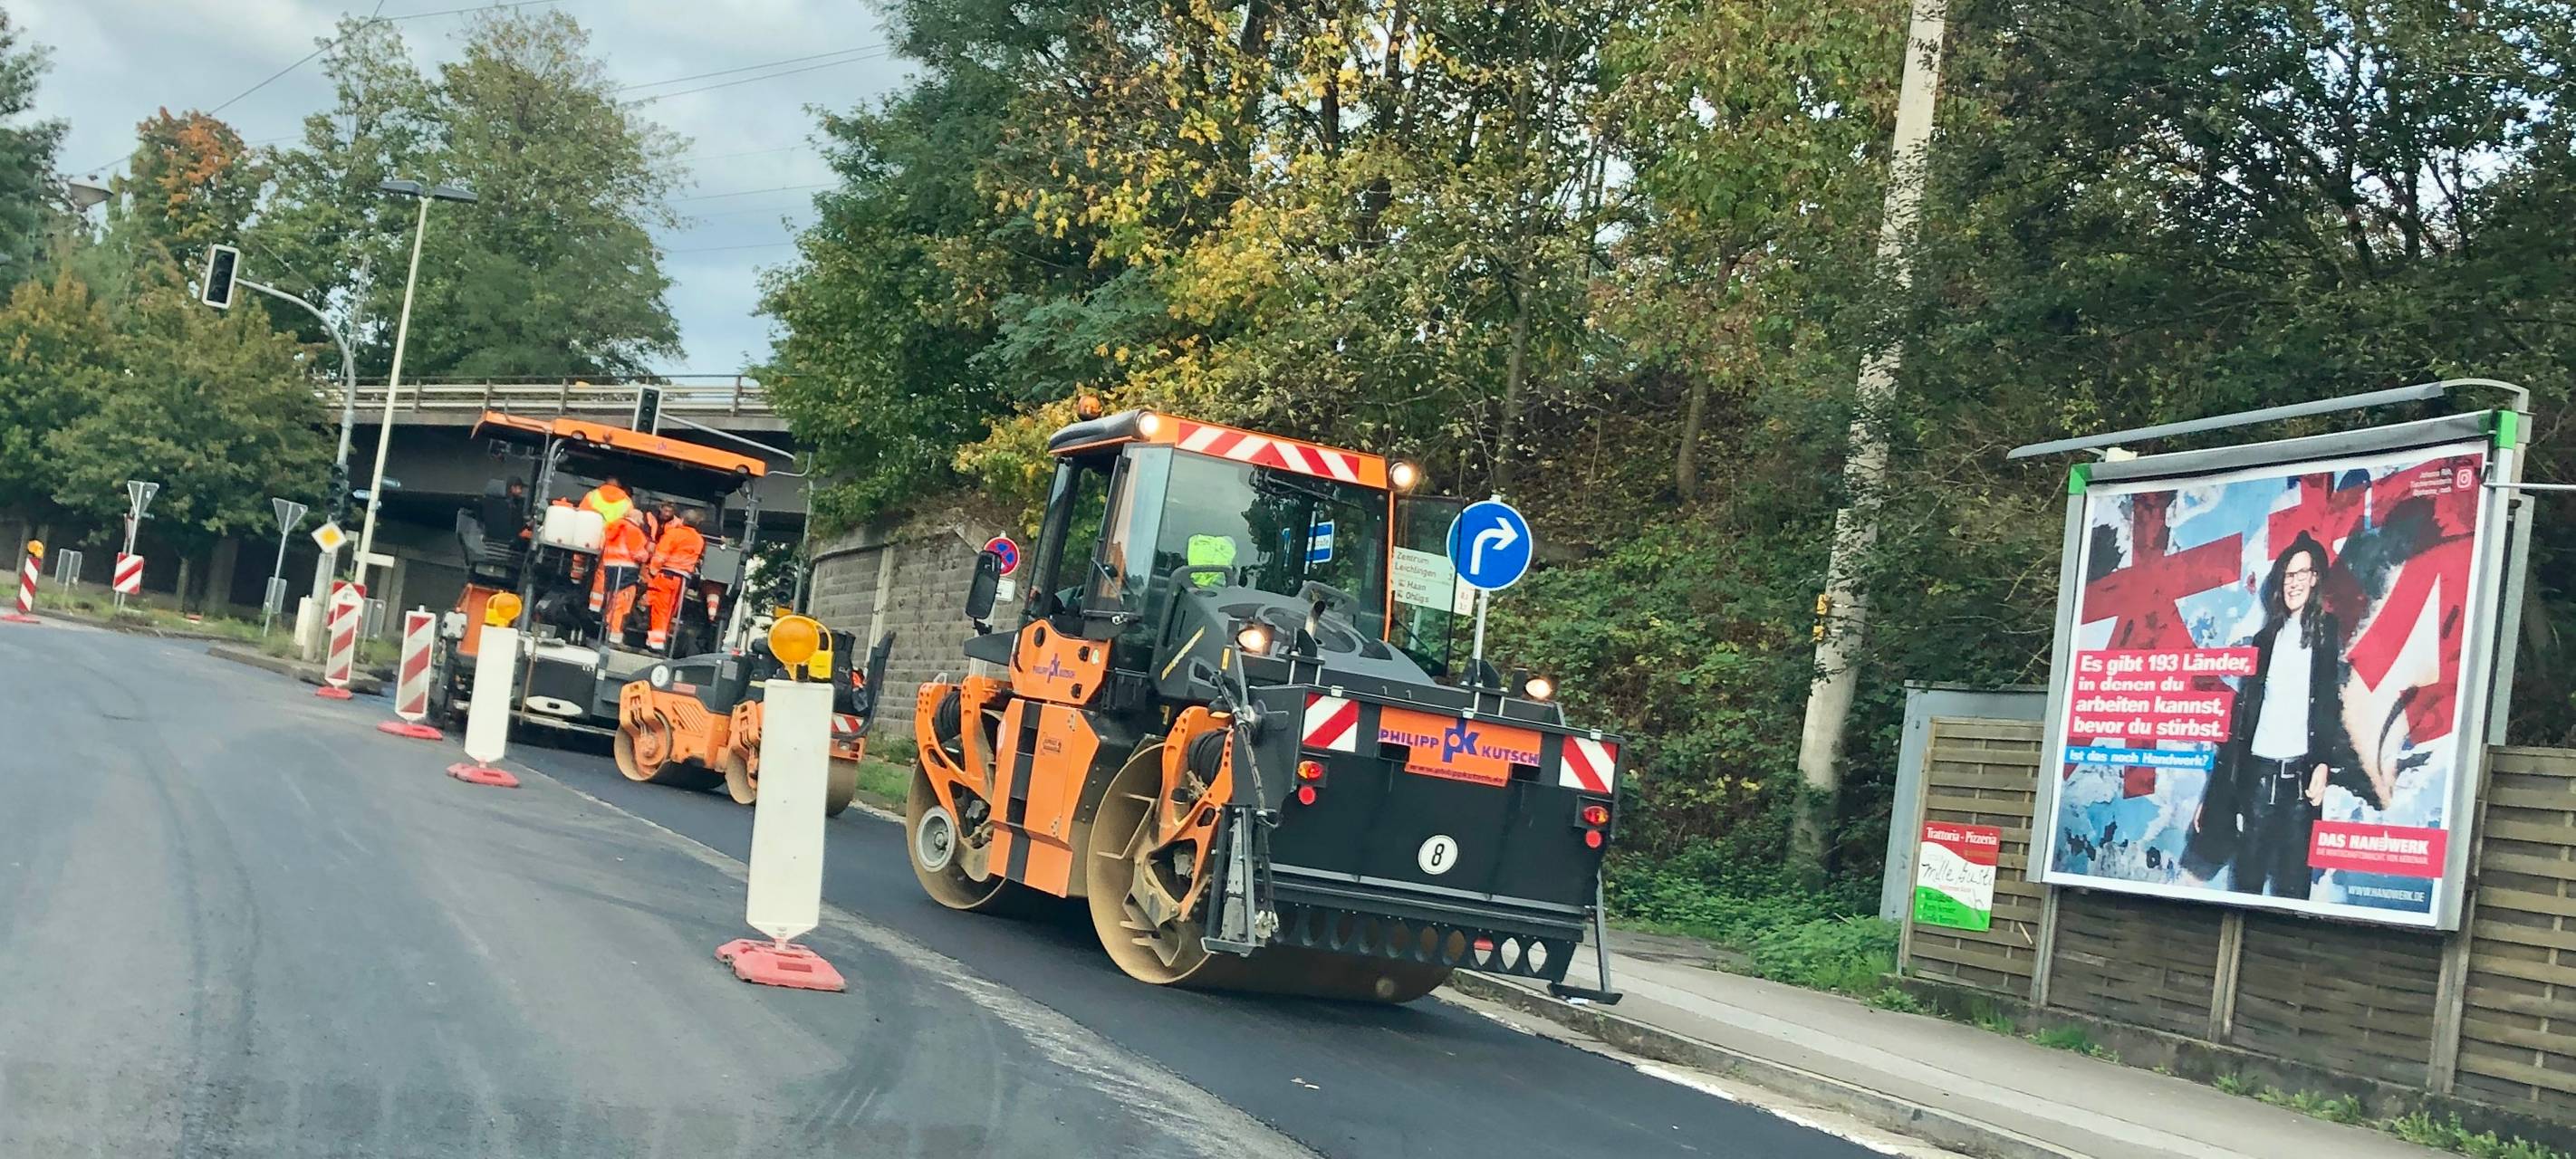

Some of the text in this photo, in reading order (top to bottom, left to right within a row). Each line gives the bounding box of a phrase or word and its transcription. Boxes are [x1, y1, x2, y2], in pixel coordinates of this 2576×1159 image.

[1397, 551, 1429, 564] Zentrum
[1395, 562, 1437, 578] Leichlingen
[1407, 580, 1427, 591] Haan
[1405, 591, 1429, 604] Ohligs
[2080, 653, 2251, 675] Es gibt 193 Länder,
[2078, 675, 2186, 692] in denen du
[2075, 694, 2225, 716] arbeiten kannst,
[2072, 715, 2225, 738] bevor du stirbst.
[1379, 728, 1440, 749] PHILIPP
[1481, 745, 1541, 766] KUTSCH
[2069, 748, 2210, 767] Ist das noch Handwerk?
[1409, 764, 1504, 784] www.philippkutsch.de
[1926, 827, 1960, 842] Trattoria
[1965, 830, 1997, 846] Pizzeria
[2317, 830, 2429, 856] DAS HANDWERK
[1430, 843, 1446, 867] 8
[2348, 886, 2427, 903] WWW.HANDWERK.DE
